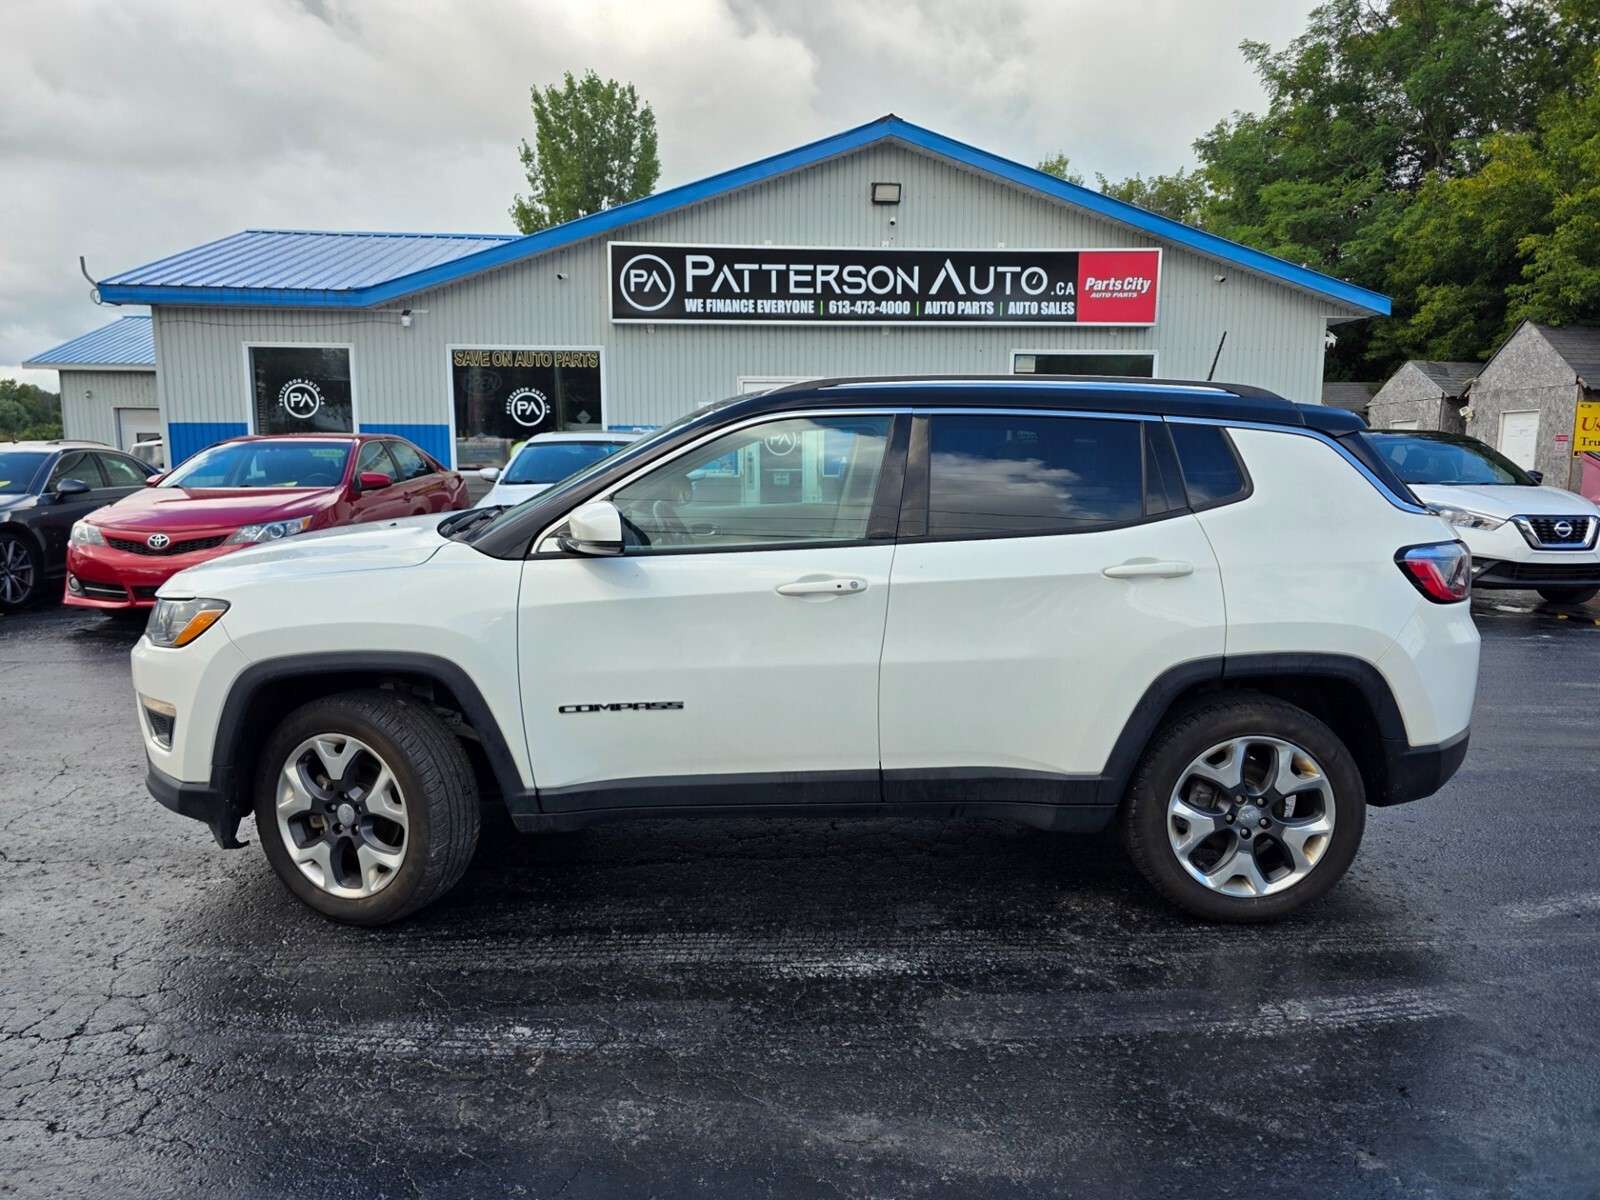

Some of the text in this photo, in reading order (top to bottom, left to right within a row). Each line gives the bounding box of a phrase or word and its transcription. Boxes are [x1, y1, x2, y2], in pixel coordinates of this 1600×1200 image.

[629, 268, 667, 293] PA
[685, 254, 919, 295] PATTERSON
[928, 258, 1049, 295] AUTO
[684, 299, 1075, 315] WE FINANCE EVERYONE 613-473-4000 AUTO PARTS AUTO SALES
[454, 350, 598, 368] SAVE ON AUTO PARTS
[290, 392, 315, 408] PA
[517, 401, 541, 416] PA
[558, 701, 684, 714] COMPASS
